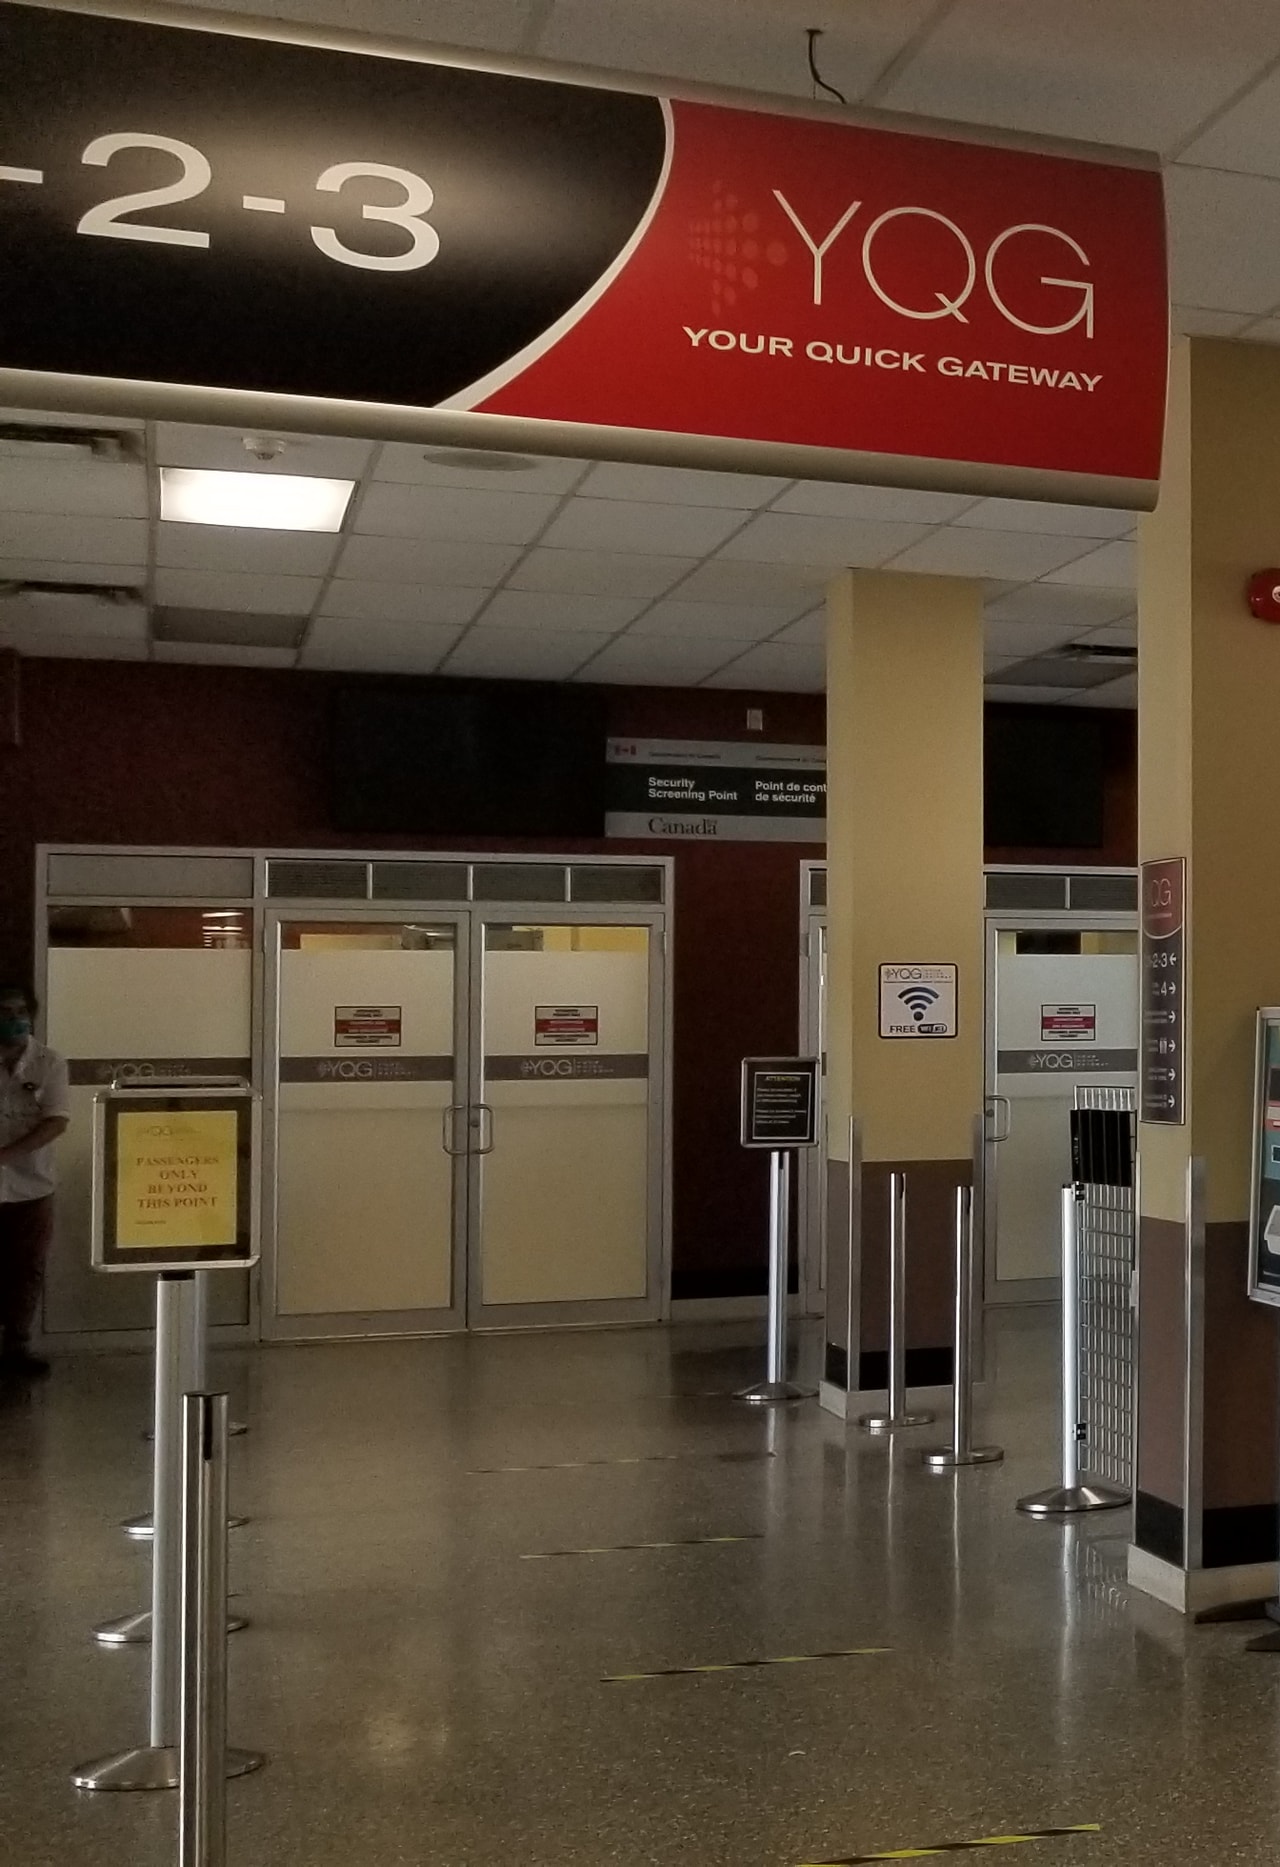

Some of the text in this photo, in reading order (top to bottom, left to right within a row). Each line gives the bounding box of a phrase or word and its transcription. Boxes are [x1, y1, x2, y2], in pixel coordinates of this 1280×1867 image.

[772, 189, 1094, 339] YQG
[682, 326, 1103, 392] YOUR QUICK GATEWAY
[648, 777, 696, 790] Security
[755, 780, 784, 791] Point
[786, 782, 801, 791] de
[648, 788, 738, 801] Screening Point
[755, 792, 816, 803] de sécurité
[648, 816, 718, 835] Canada
[892, 967, 922, 979] YQG
[889, 1025, 916, 1033] FREE
[529, 1059, 573, 1076] YQG
[1036, 1053, 1073, 1069] YQG
[328, 1060, 373, 1077] YQG
[137, 1155, 219, 1167] PASSENGERS
[159, 1169, 198, 1180] ONLY
[148, 1182, 208, 1194] BEYOND
[138, 1196, 218, 1209] THIS POINT
